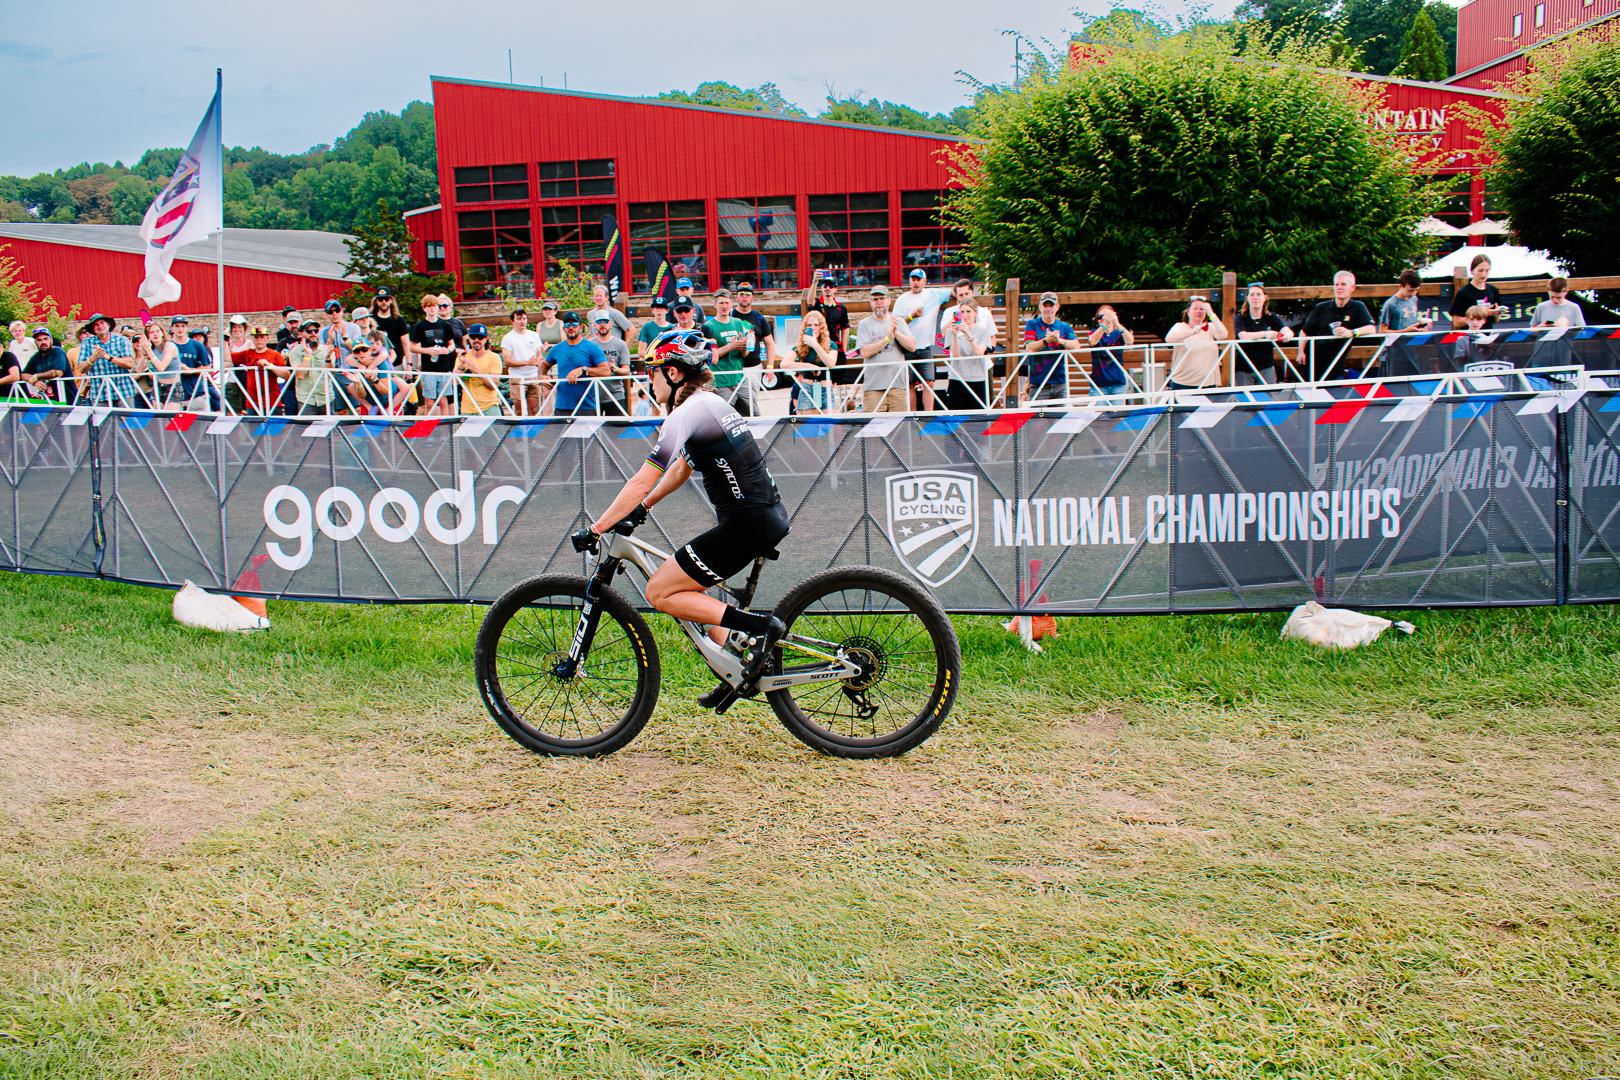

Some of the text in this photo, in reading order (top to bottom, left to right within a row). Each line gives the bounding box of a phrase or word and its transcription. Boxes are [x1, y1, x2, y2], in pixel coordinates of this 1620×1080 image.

[1362, 109, 1446, 130] NTAIN
[899, 481, 966, 503] USA
[899, 504, 966, 516] CYCLING
[263, 470, 528, 571] goodr
[993, 487, 1401, 547] NATIONAL CHAMPIONSHIPS
[685, 544, 724, 581] SCOTT
[569, 613, 589, 661] SID
[809, 672, 840, 680] SCOTT
[933, 668, 951, 716] MAXXIS
